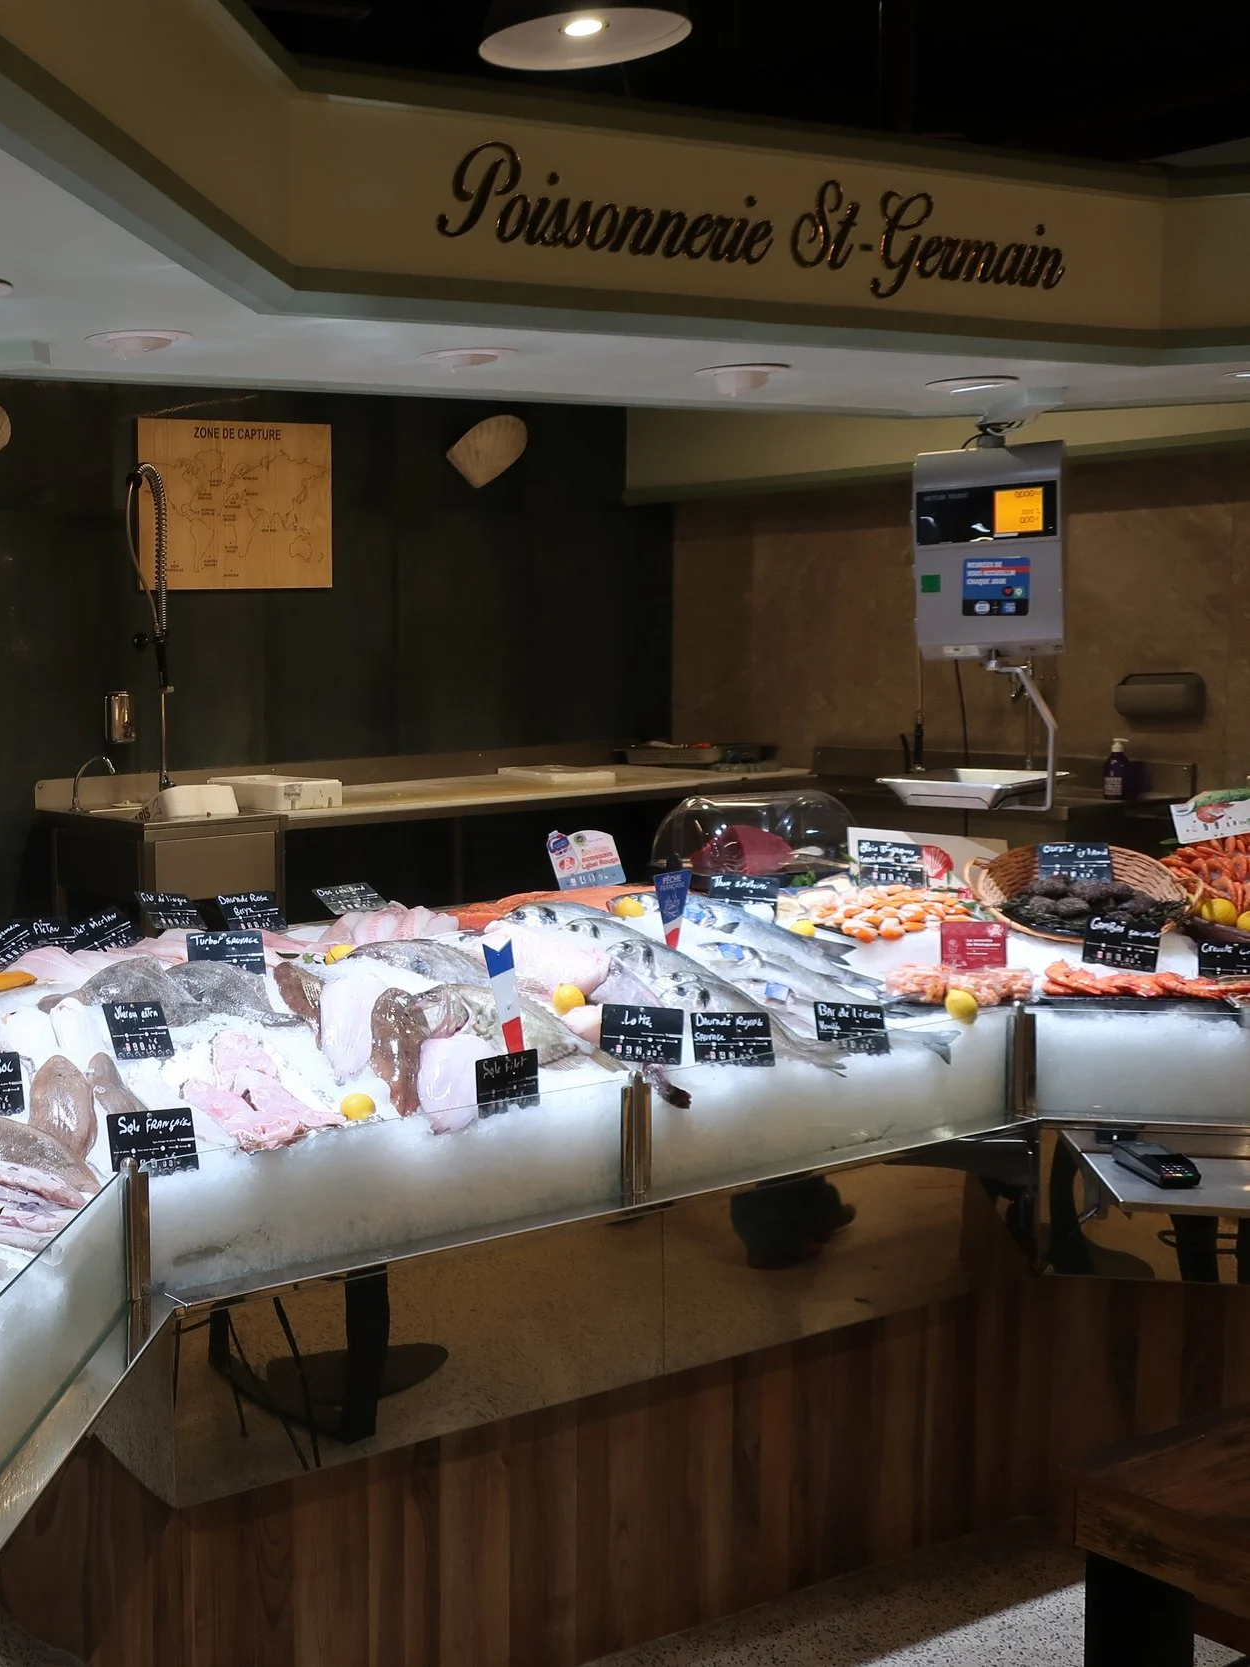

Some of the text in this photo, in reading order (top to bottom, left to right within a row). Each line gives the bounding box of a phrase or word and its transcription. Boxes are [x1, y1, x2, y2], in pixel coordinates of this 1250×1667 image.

[436, 140, 1066, 299] Poissonnerie St-Germain
[194, 427, 281, 440] ZONE DE CAPTURE
[662, 873, 682, 884] PÊCHE
